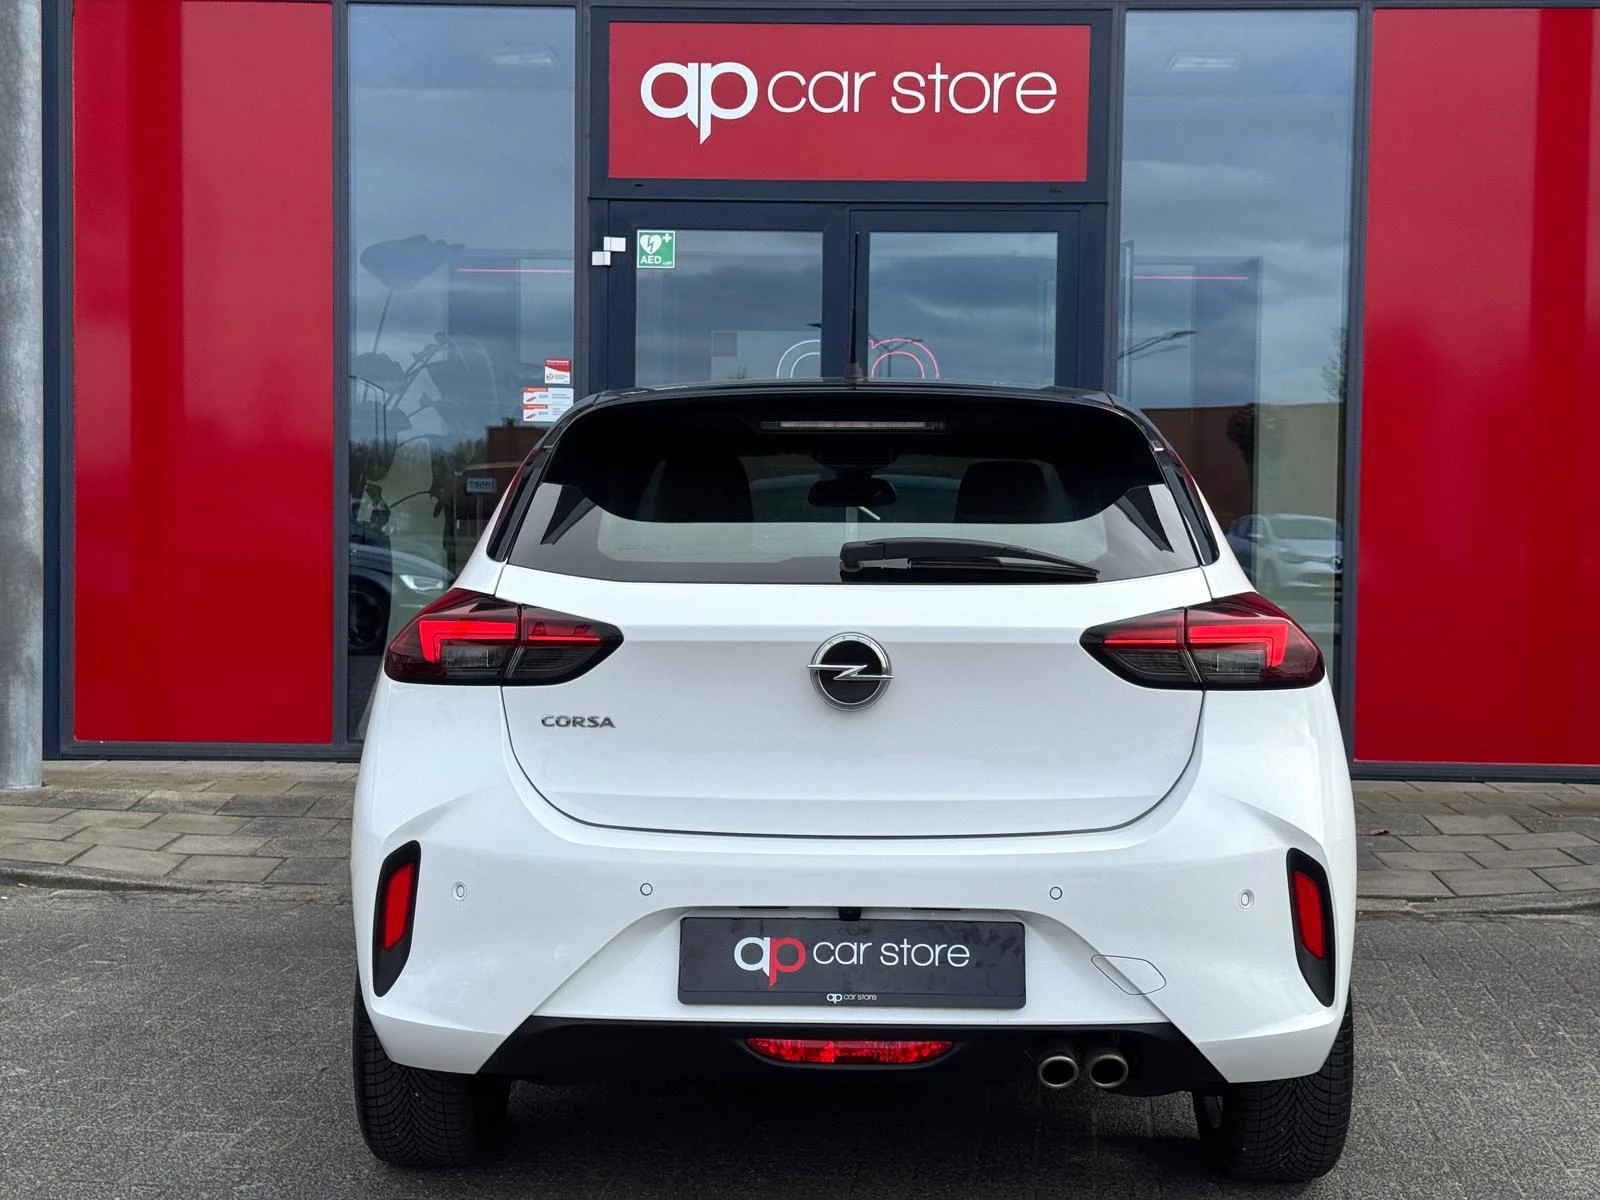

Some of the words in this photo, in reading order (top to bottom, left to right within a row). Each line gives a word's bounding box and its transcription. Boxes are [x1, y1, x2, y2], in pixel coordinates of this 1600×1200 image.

[640, 62, 759, 145] ap
[767, 70, 877, 114] car
[890, 62, 1058, 115] store
[640, 255, 662, 265] AED
[541, 715, 617, 729] CORSA
[733, 936, 807, 988] ap
[812, 941, 873, 967] car
[879, 937, 971, 968] store
[857, 993, 878, 1001] store
